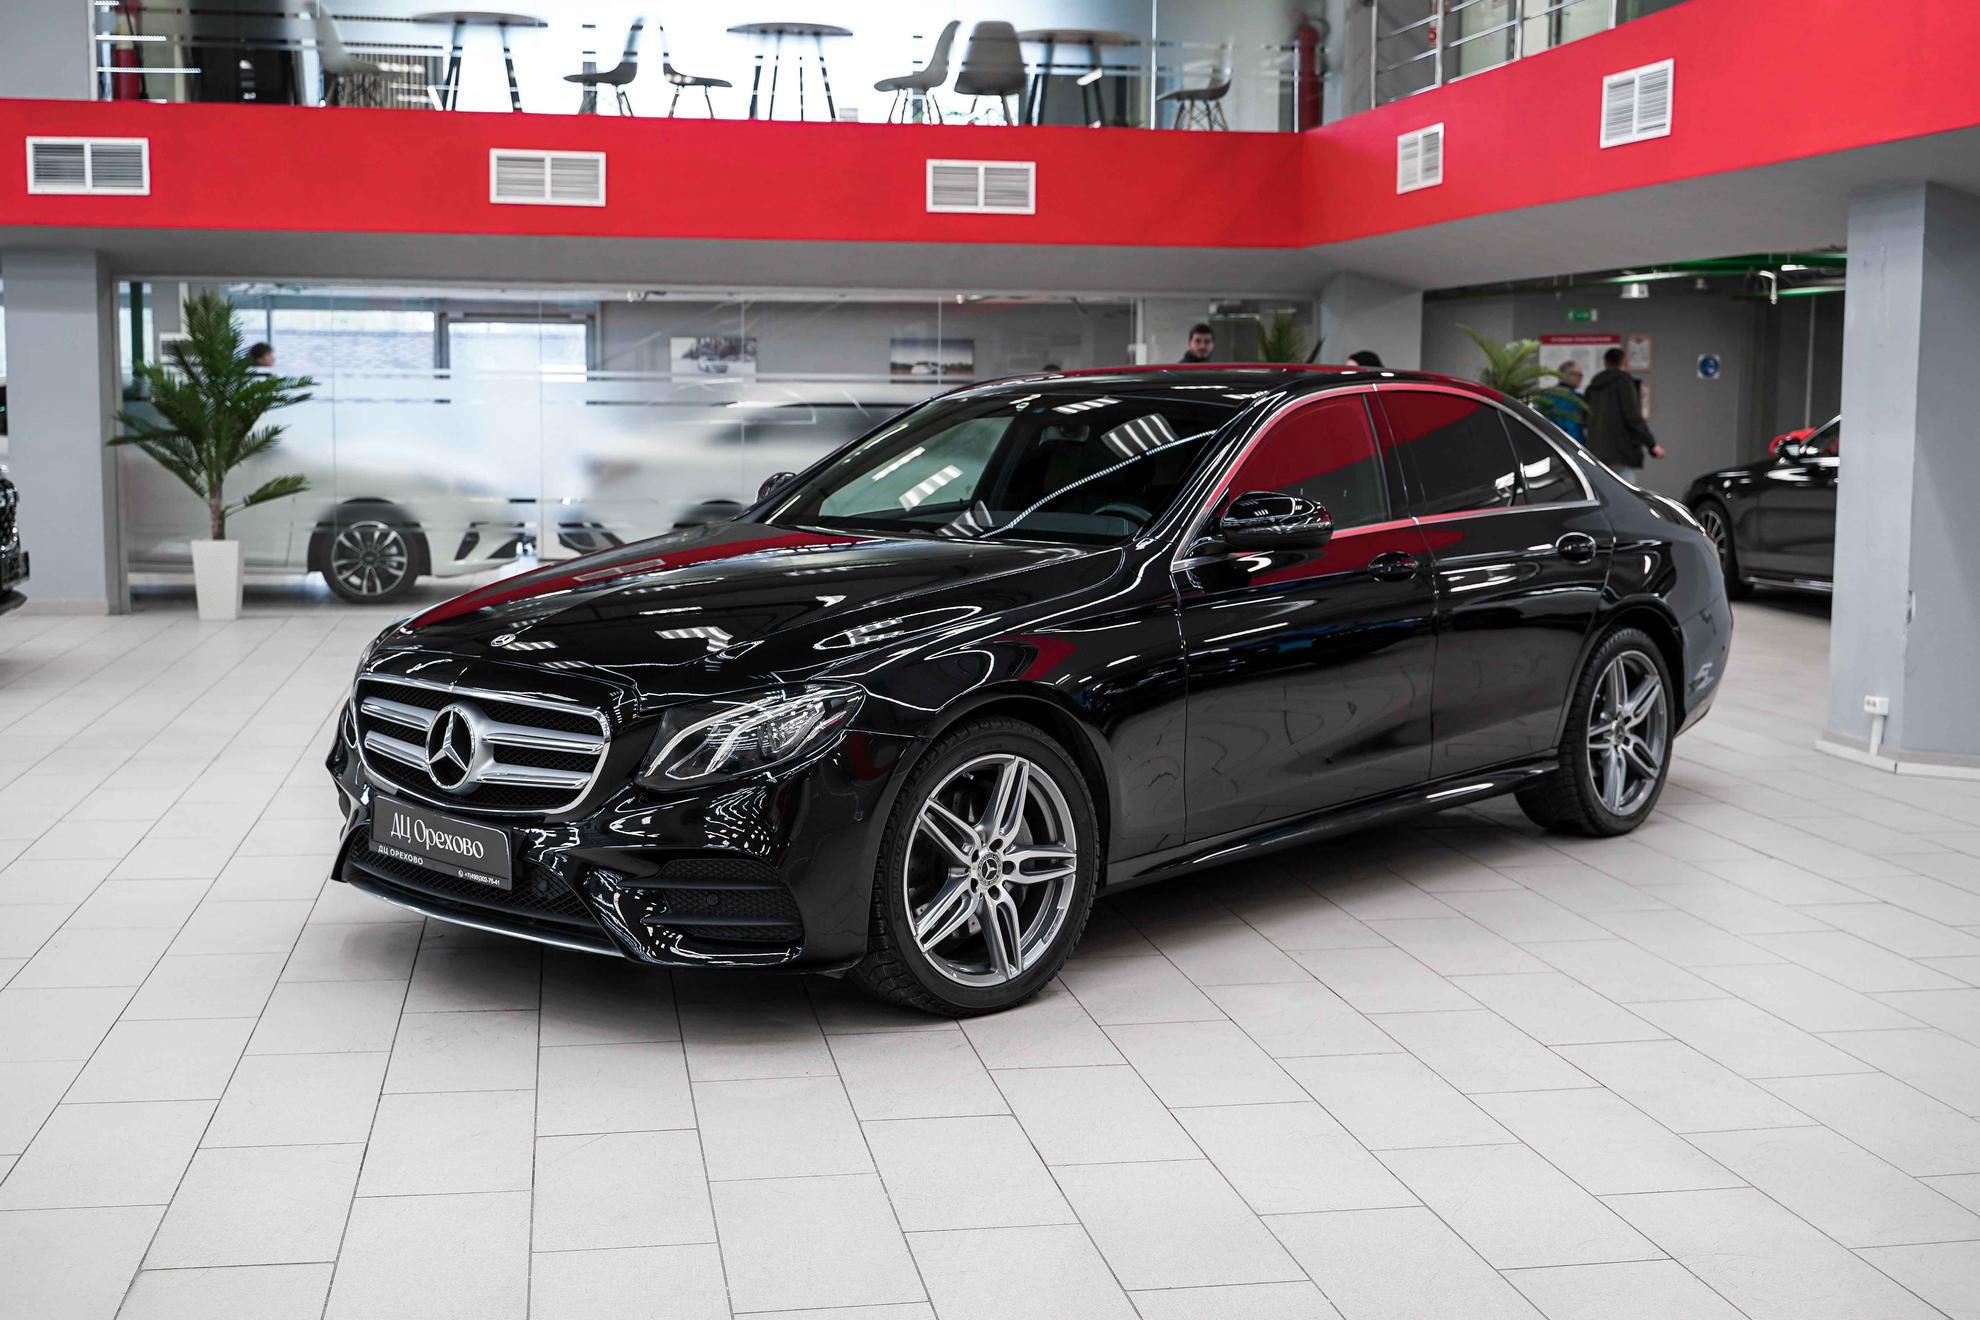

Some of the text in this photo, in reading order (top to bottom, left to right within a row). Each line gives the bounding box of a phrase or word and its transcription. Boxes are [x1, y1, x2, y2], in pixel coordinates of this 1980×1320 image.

[391, 812, 484, 859] ДЦ Орехово
[378, 845, 424, 865] ДЦ ОРЕХОВО
